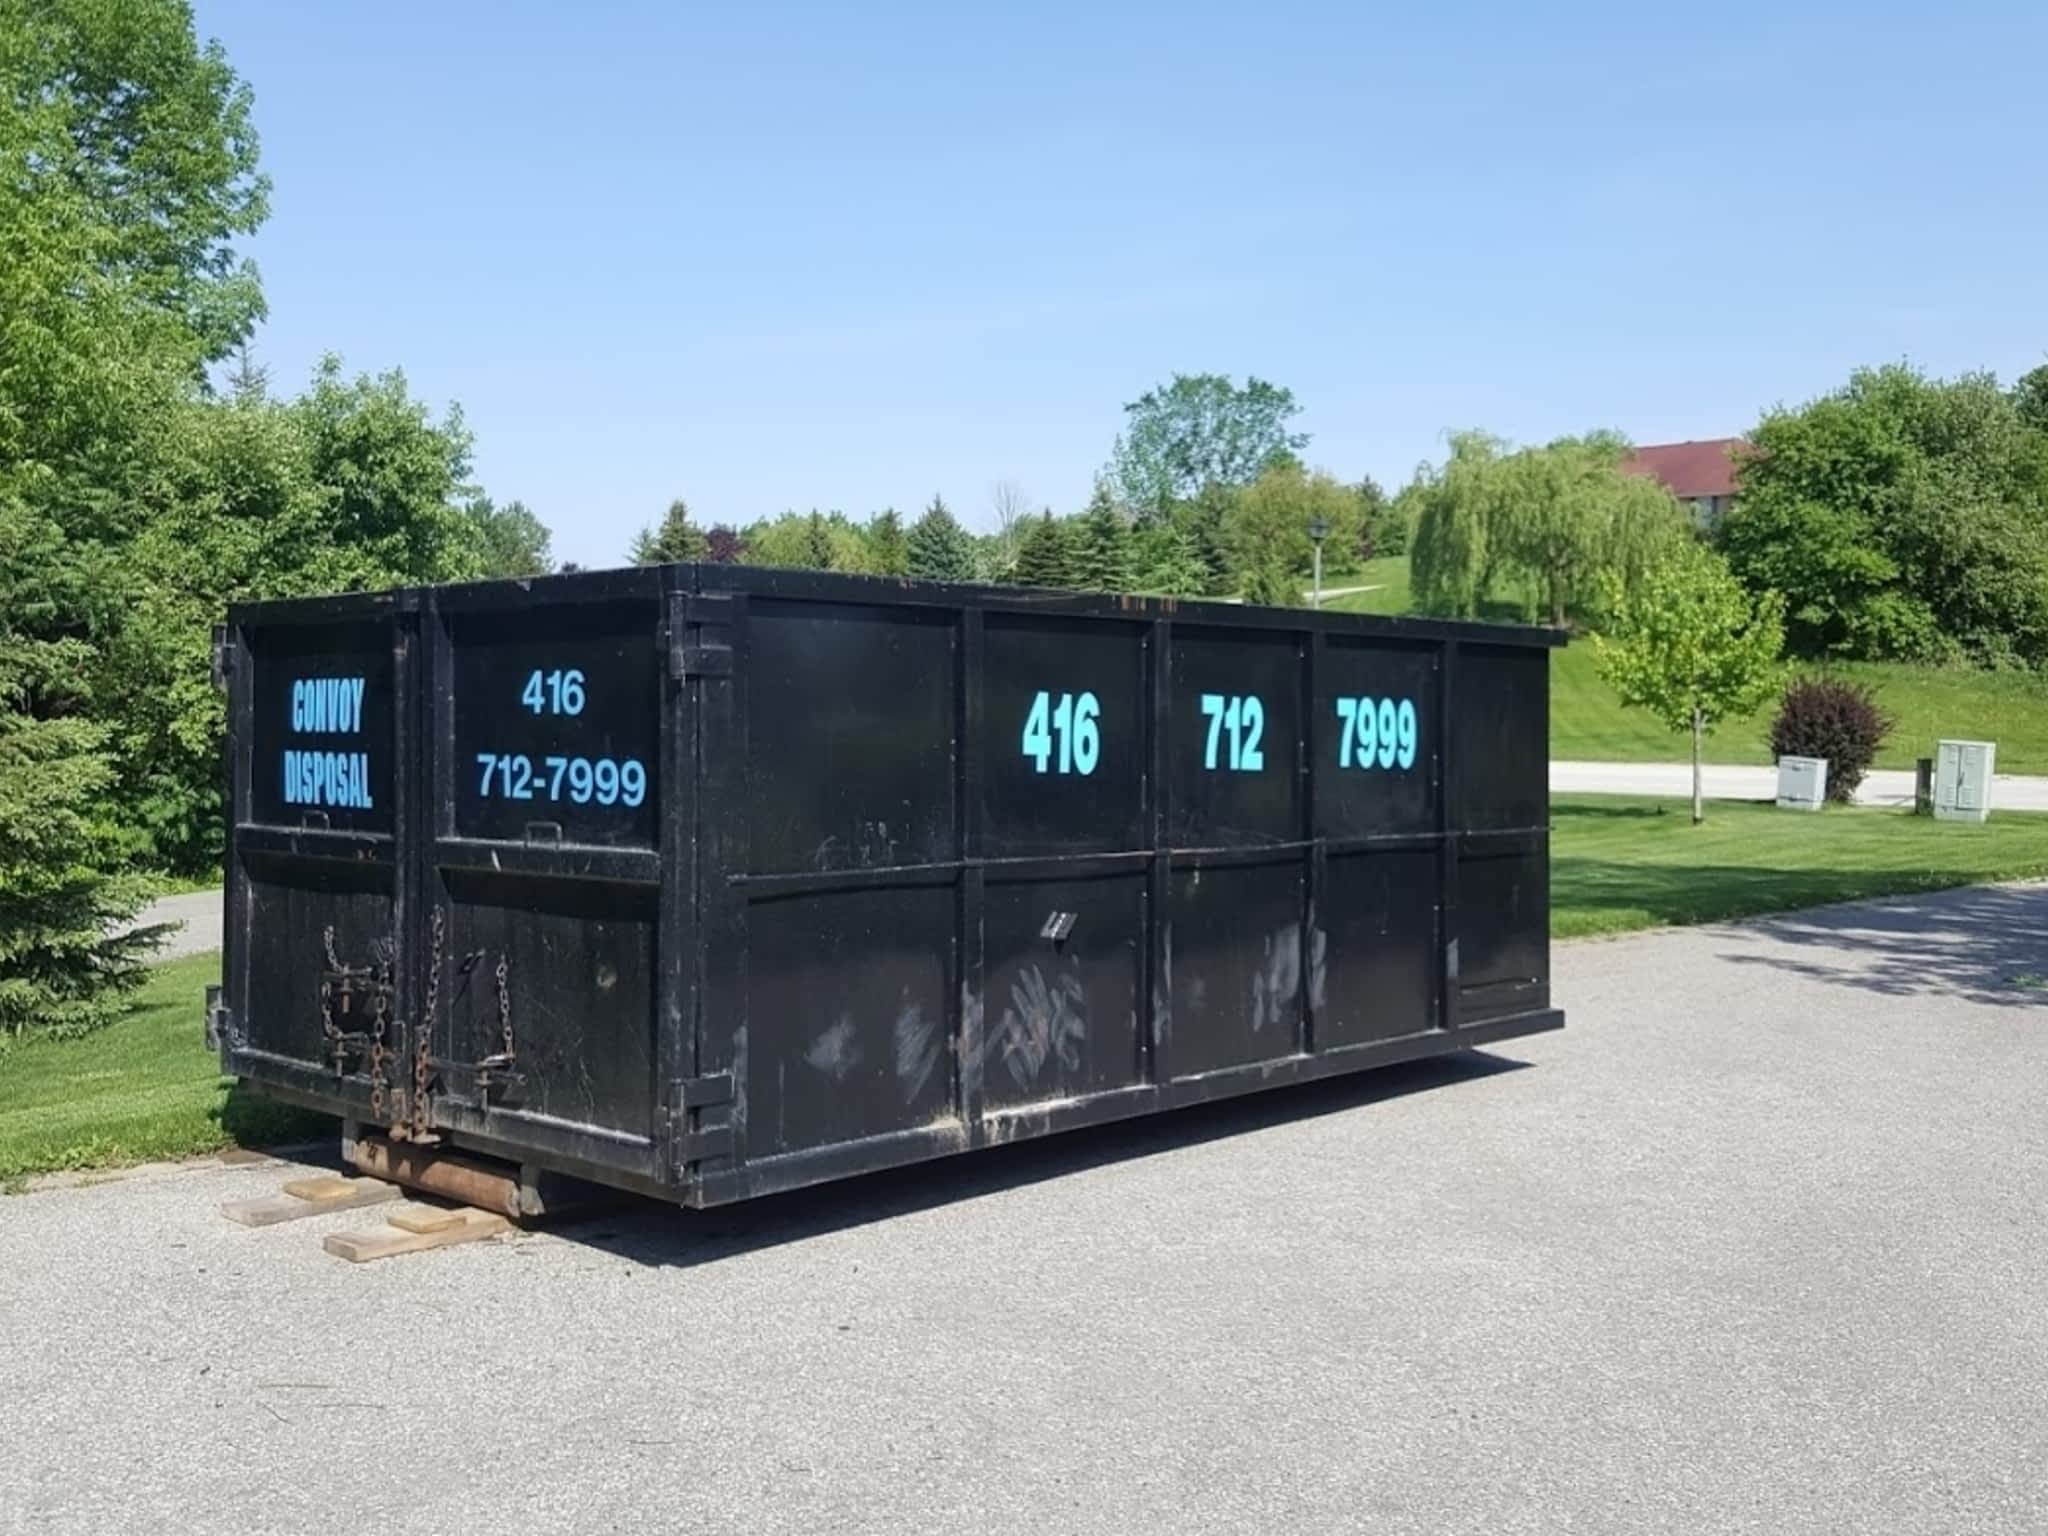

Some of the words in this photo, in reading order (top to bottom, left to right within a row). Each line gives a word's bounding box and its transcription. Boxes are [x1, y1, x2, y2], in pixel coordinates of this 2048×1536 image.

[292, 678, 364, 732] CONVOY
[522, 670, 585, 715] 416
[1022, 691, 1100, 775] 416
[1201, 694, 1264, 772] 712
[1337, 696, 1417, 769] 7999
[284, 751, 372, 808] DISPOSAL
[477, 754, 646, 807] 712-7999
